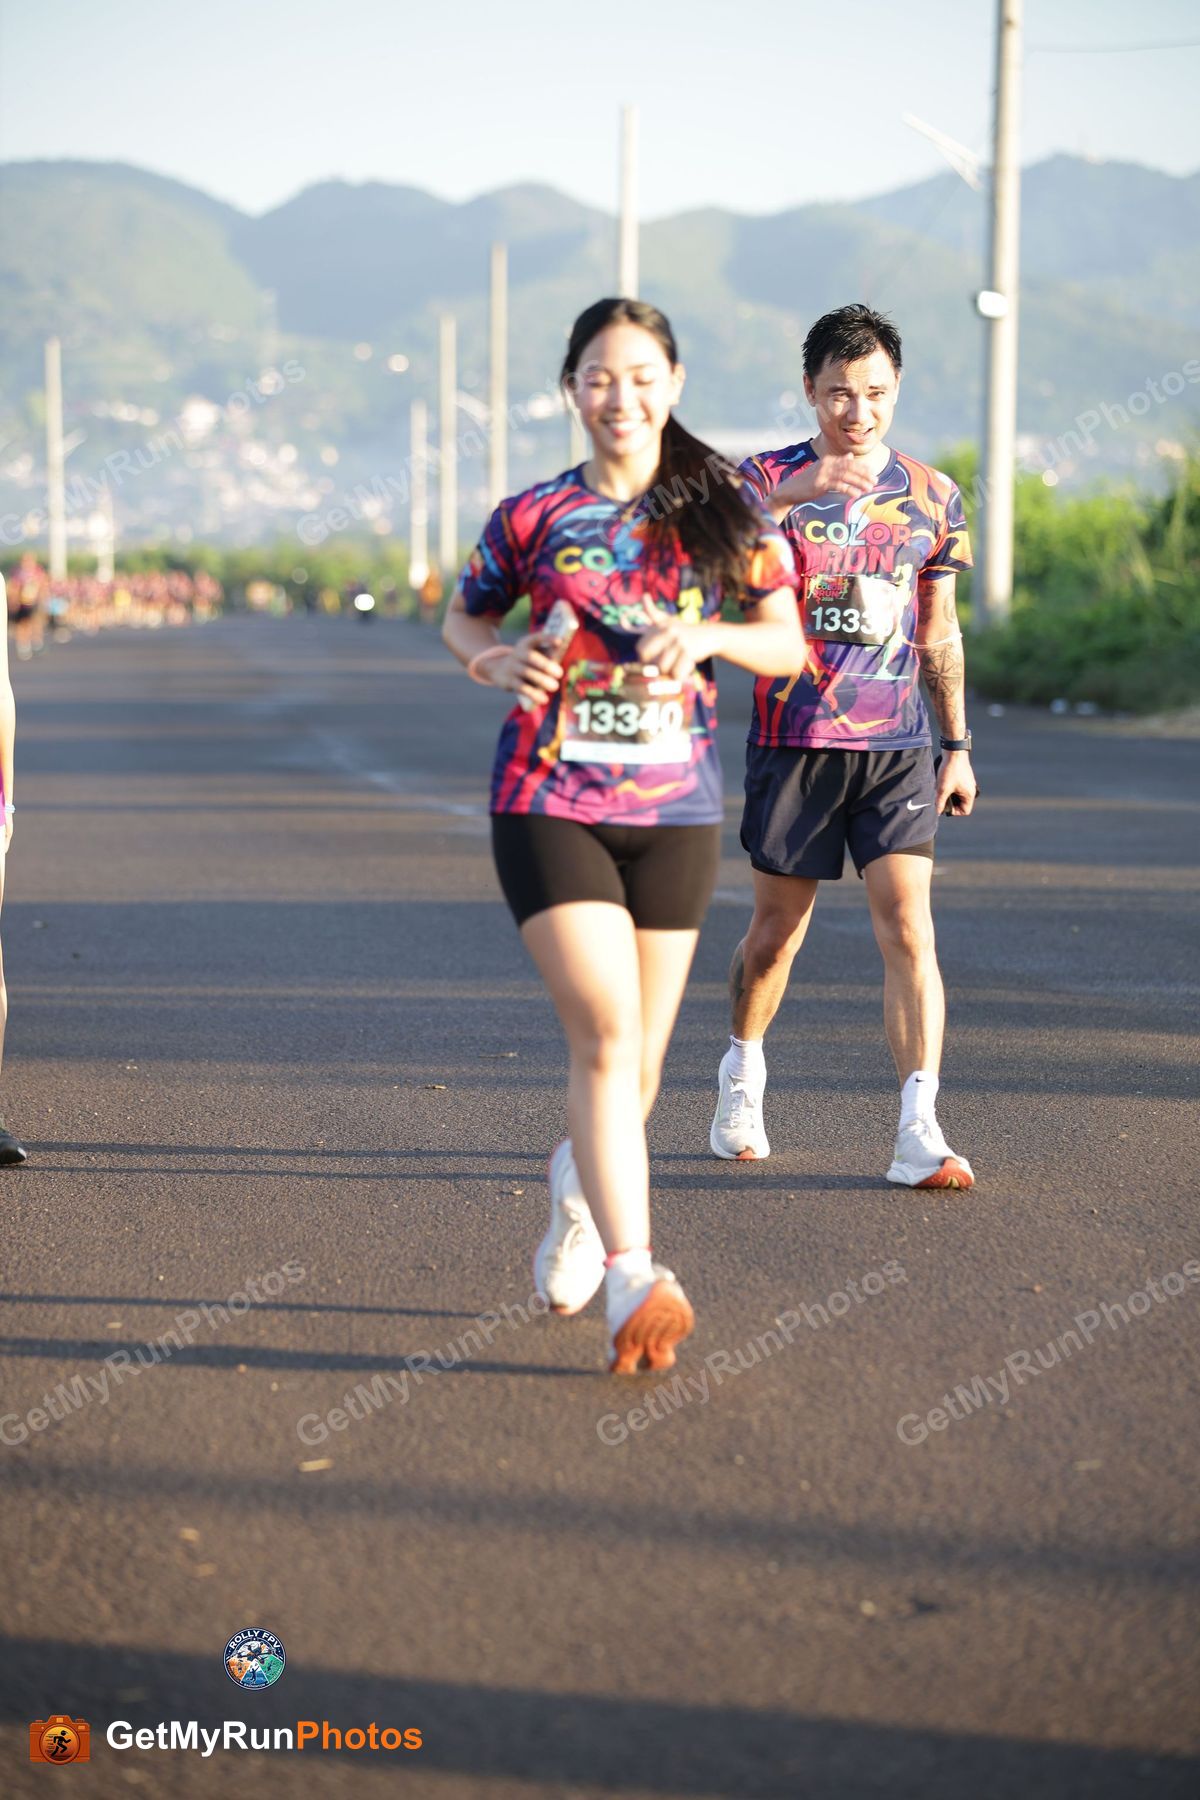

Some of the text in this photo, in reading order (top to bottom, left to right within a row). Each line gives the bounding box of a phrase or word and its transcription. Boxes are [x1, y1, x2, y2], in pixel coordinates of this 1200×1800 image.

[804, 520, 913, 547] COLOR
[818, 545, 895, 573] RUN
[811, 606, 894, 637] 1333
[573, 699, 684, 737] 13340
